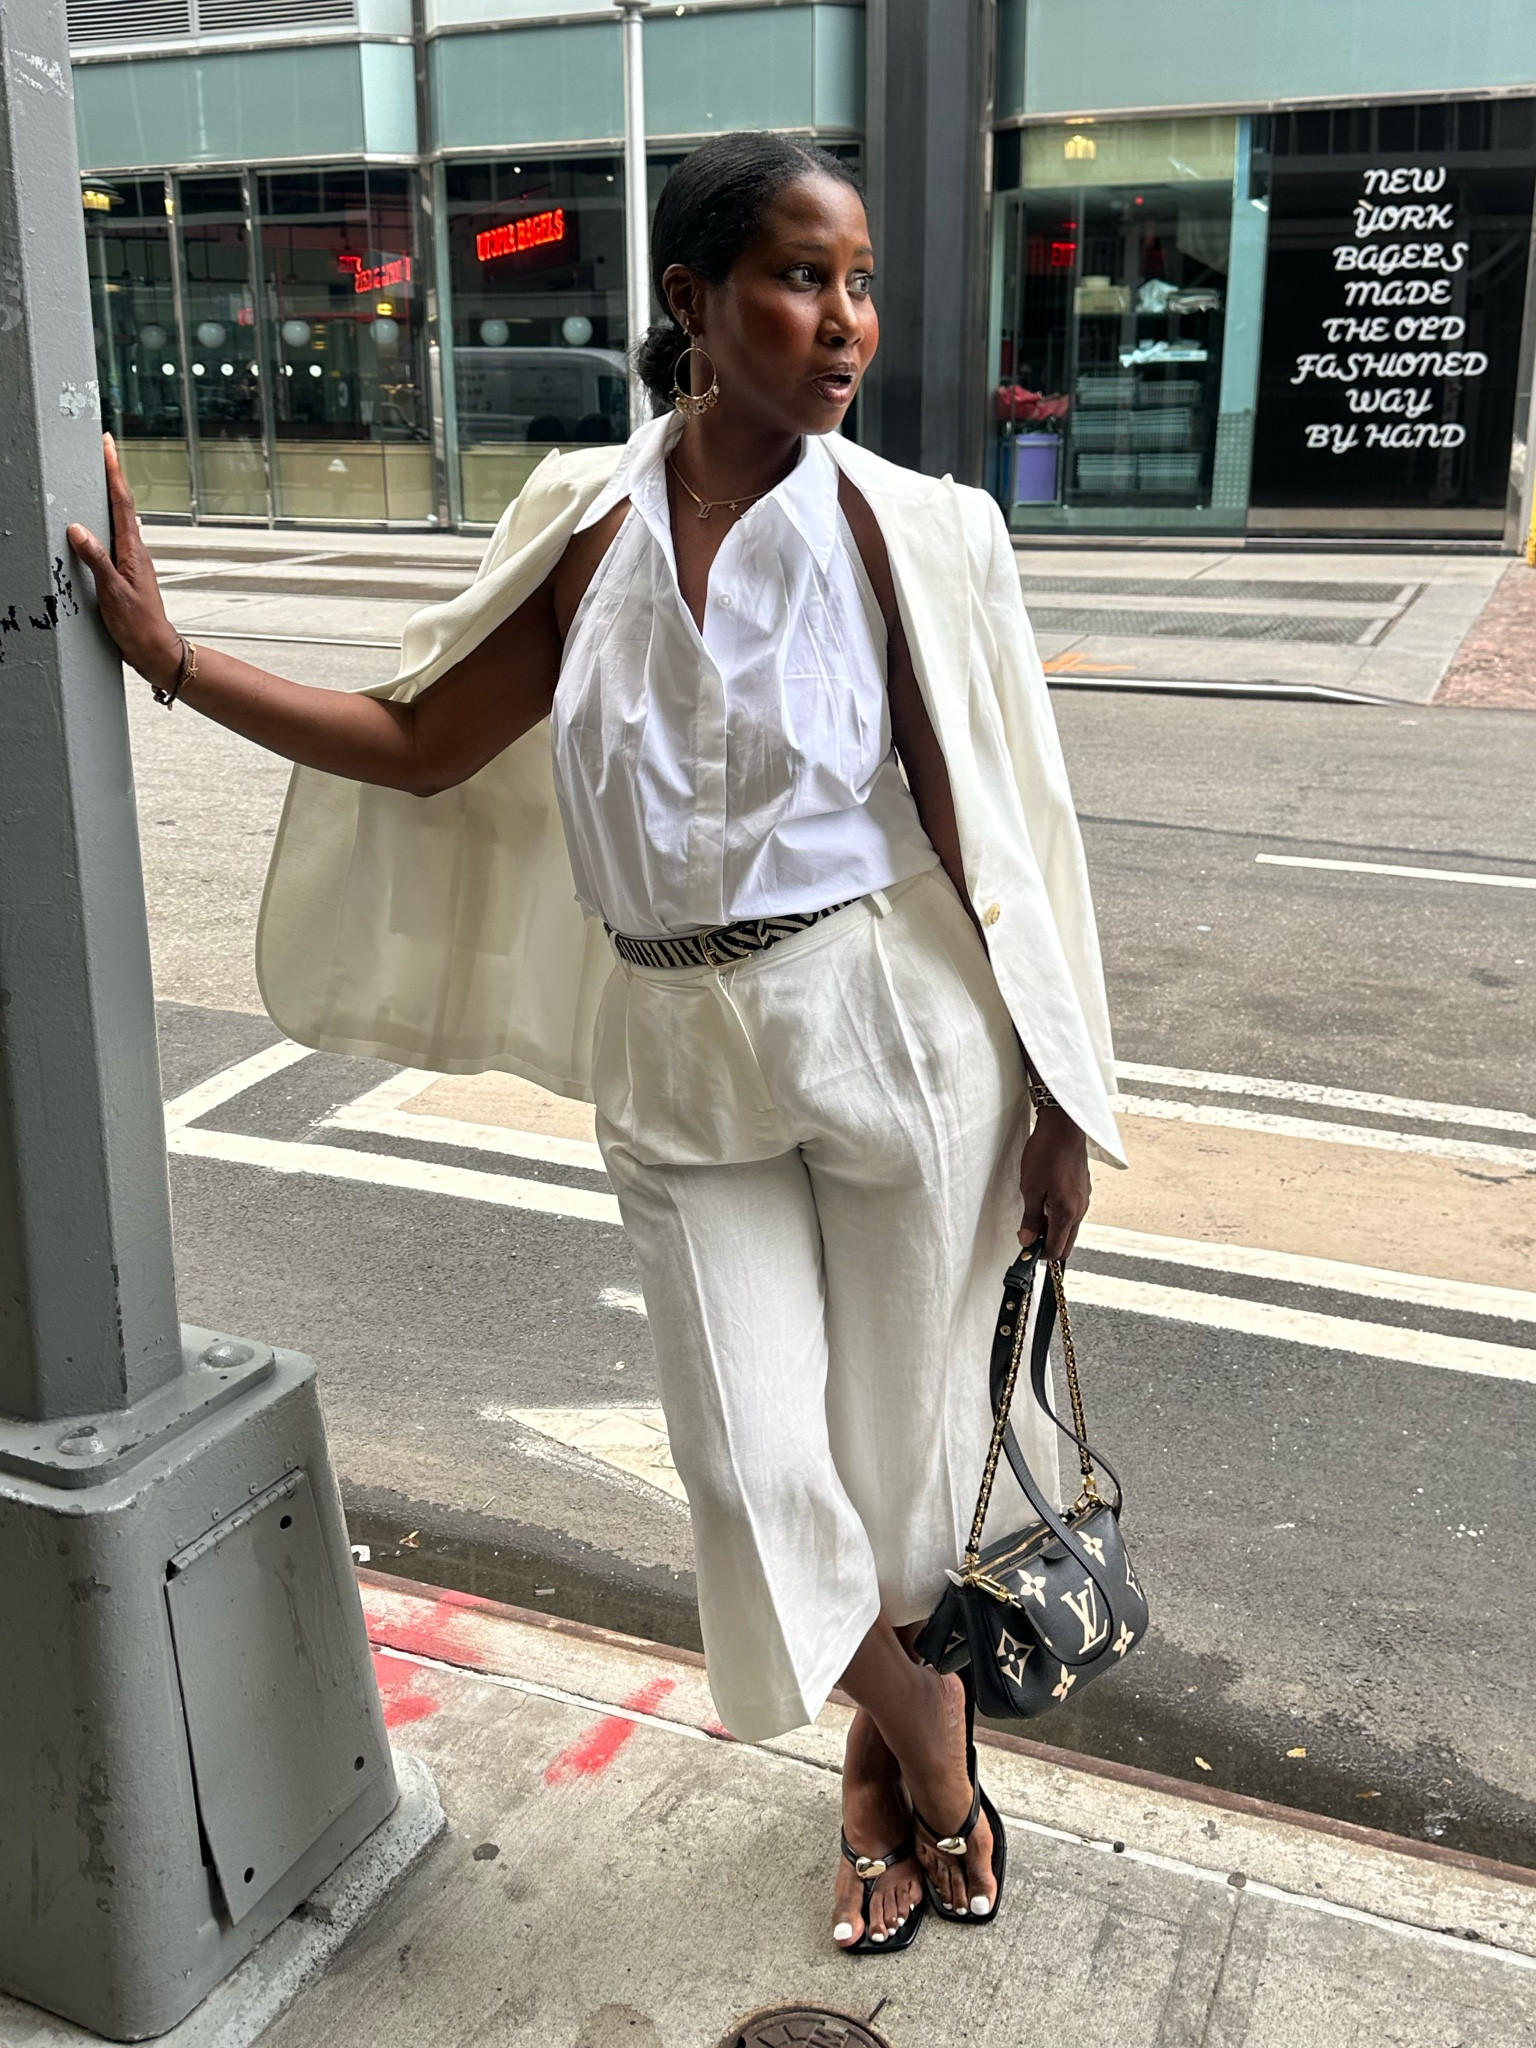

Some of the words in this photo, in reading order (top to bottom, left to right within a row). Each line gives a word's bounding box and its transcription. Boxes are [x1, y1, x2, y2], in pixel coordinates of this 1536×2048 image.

[1363, 166, 1447, 195] NEW
[1353, 202, 1454, 238] YORK
[1332, 242, 1469, 276] BAGELS
[1344, 280, 1452, 307] MADE
[1321, 317, 1390, 343] THE
[1394, 316, 1466, 342] OLD
[1290, 352, 1488, 385] FASHIONED
[1345, 388, 1433, 418] WAY
[1304, 424, 1359, 454] BY
[1364, 424, 1466, 448] HAND
